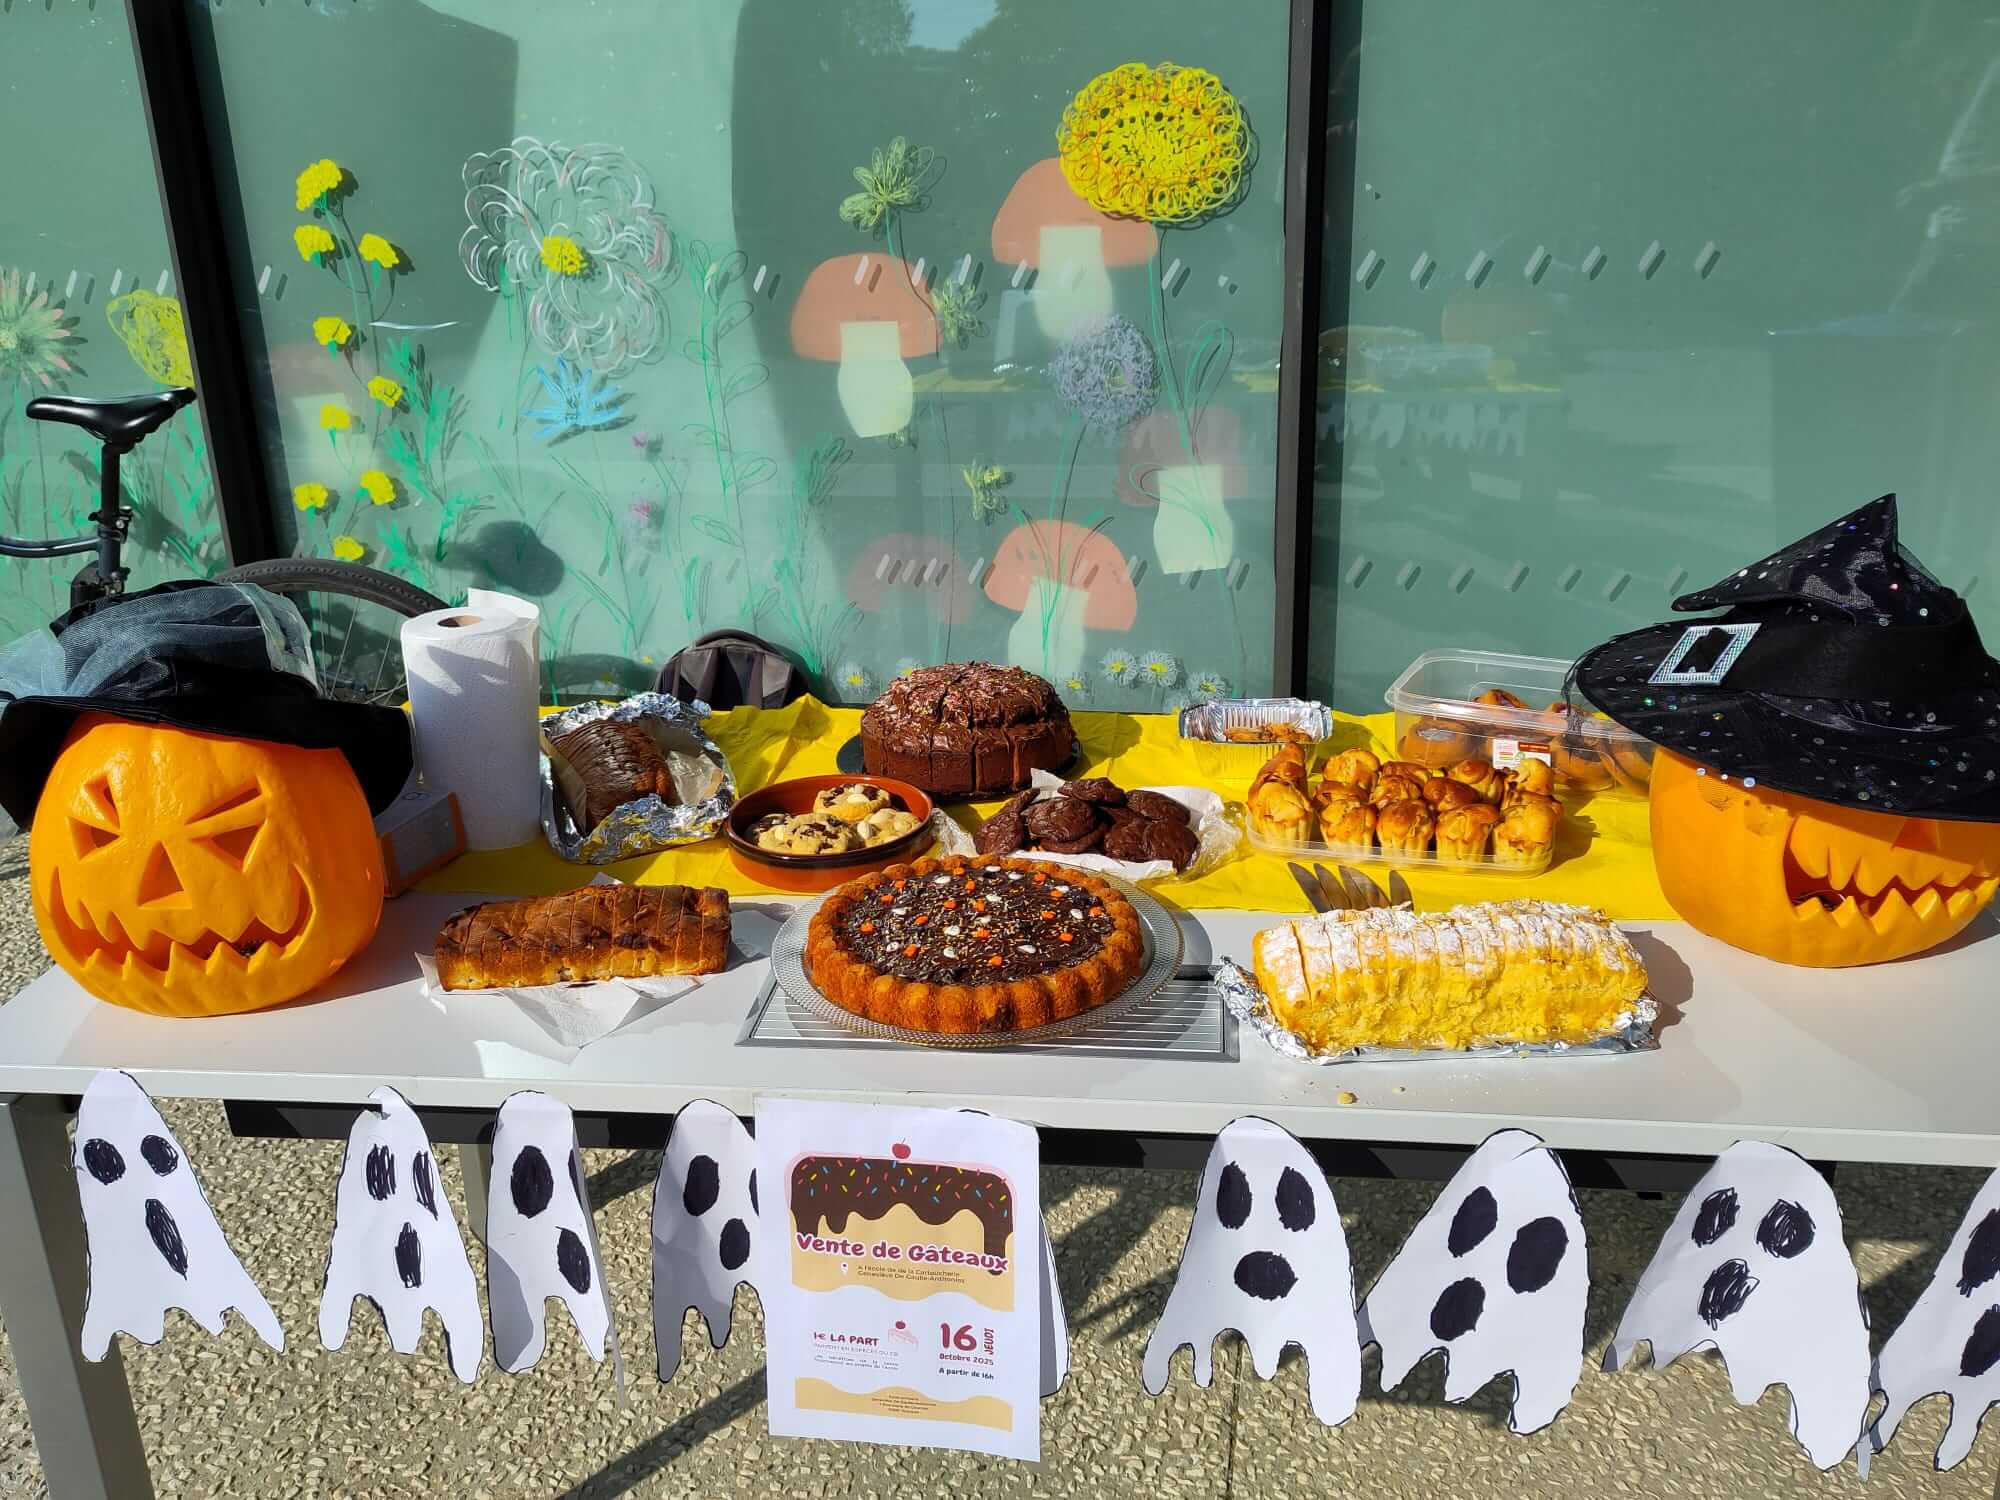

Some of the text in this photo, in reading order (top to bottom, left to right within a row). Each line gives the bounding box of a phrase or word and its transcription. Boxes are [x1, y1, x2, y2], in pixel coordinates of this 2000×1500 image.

[796, 1234, 1009, 1270] Vente de Gâteaux
[830, 1333, 846, 1343] LA
[849, 1335, 880, 1347] PART
[940, 1322, 977, 1351] 16
[984, 1327, 994, 1355] JEUDI
[939, 1352, 994, 1366] Octobre 2025
[946, 1367, 969, 1377] partir
[971, 1370, 980, 1378] de
[982, 1371, 995, 1381] 16h
